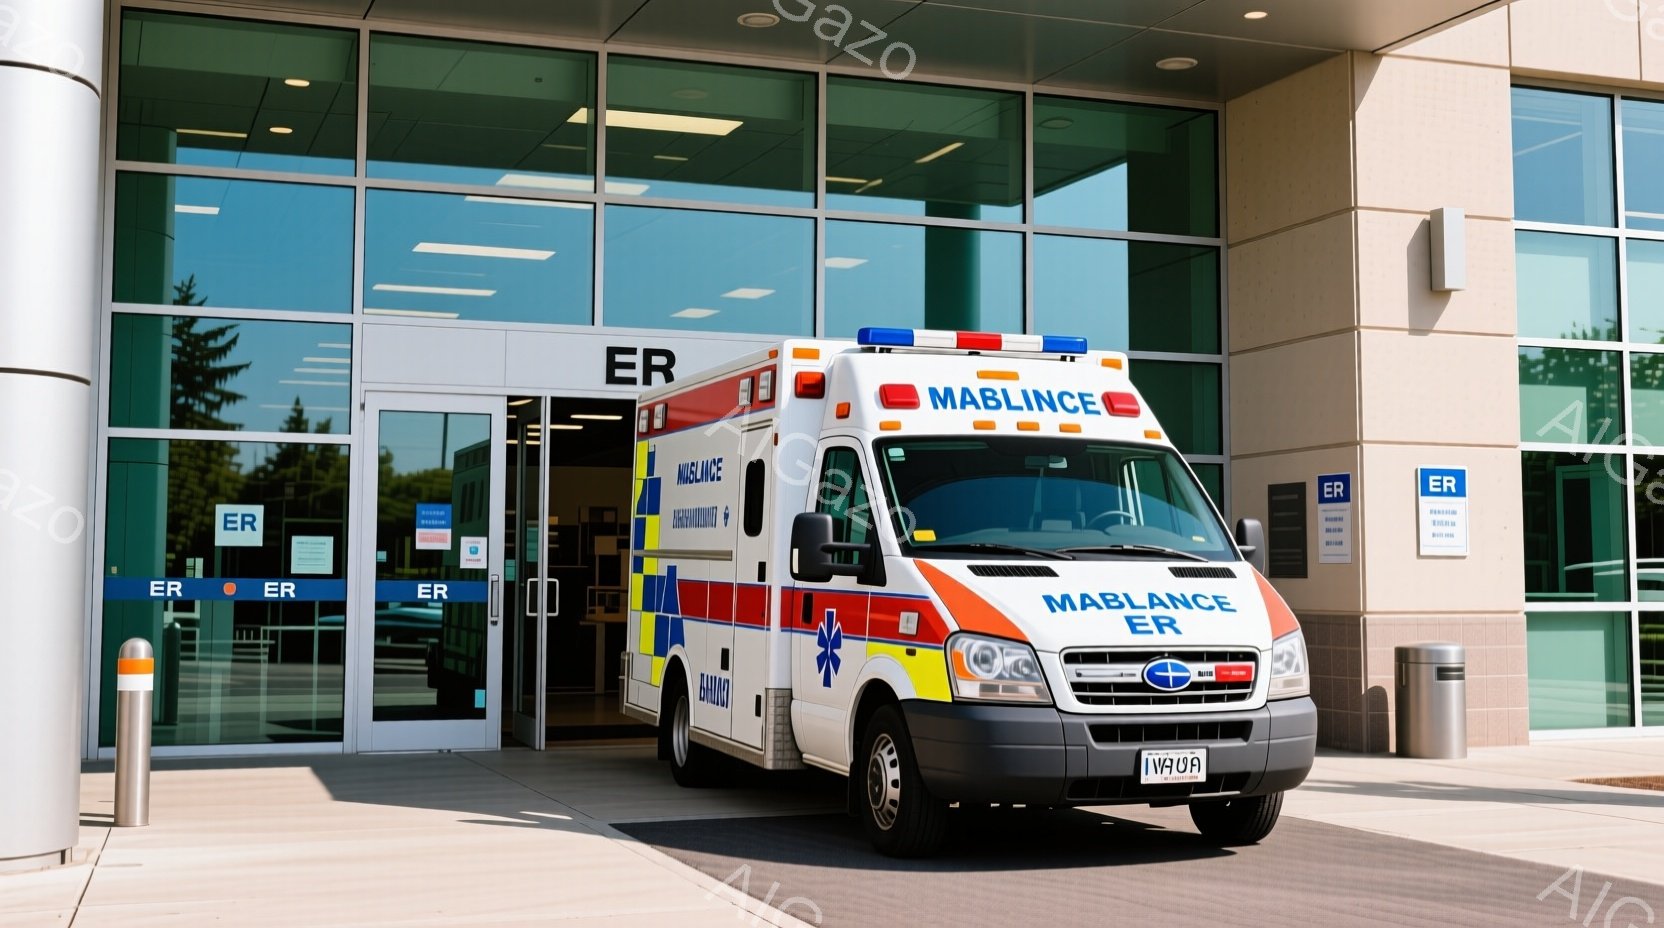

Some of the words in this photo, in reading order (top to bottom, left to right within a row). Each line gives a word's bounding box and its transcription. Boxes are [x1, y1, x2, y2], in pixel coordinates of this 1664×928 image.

[606, 346, 676, 386] ER
[928, 386, 1101, 416] MABLINCE
[1323, 481, 1344, 498] ER
[1428, 475, 1457, 493] ER
[223, 512, 257, 532] ER
[150, 581, 182, 597] ER
[264, 582, 295, 598] ER
[417, 583, 448, 599] ER
[1041, 592, 1237, 613] MABLANCE
[1123, 615, 1183, 635] ER
